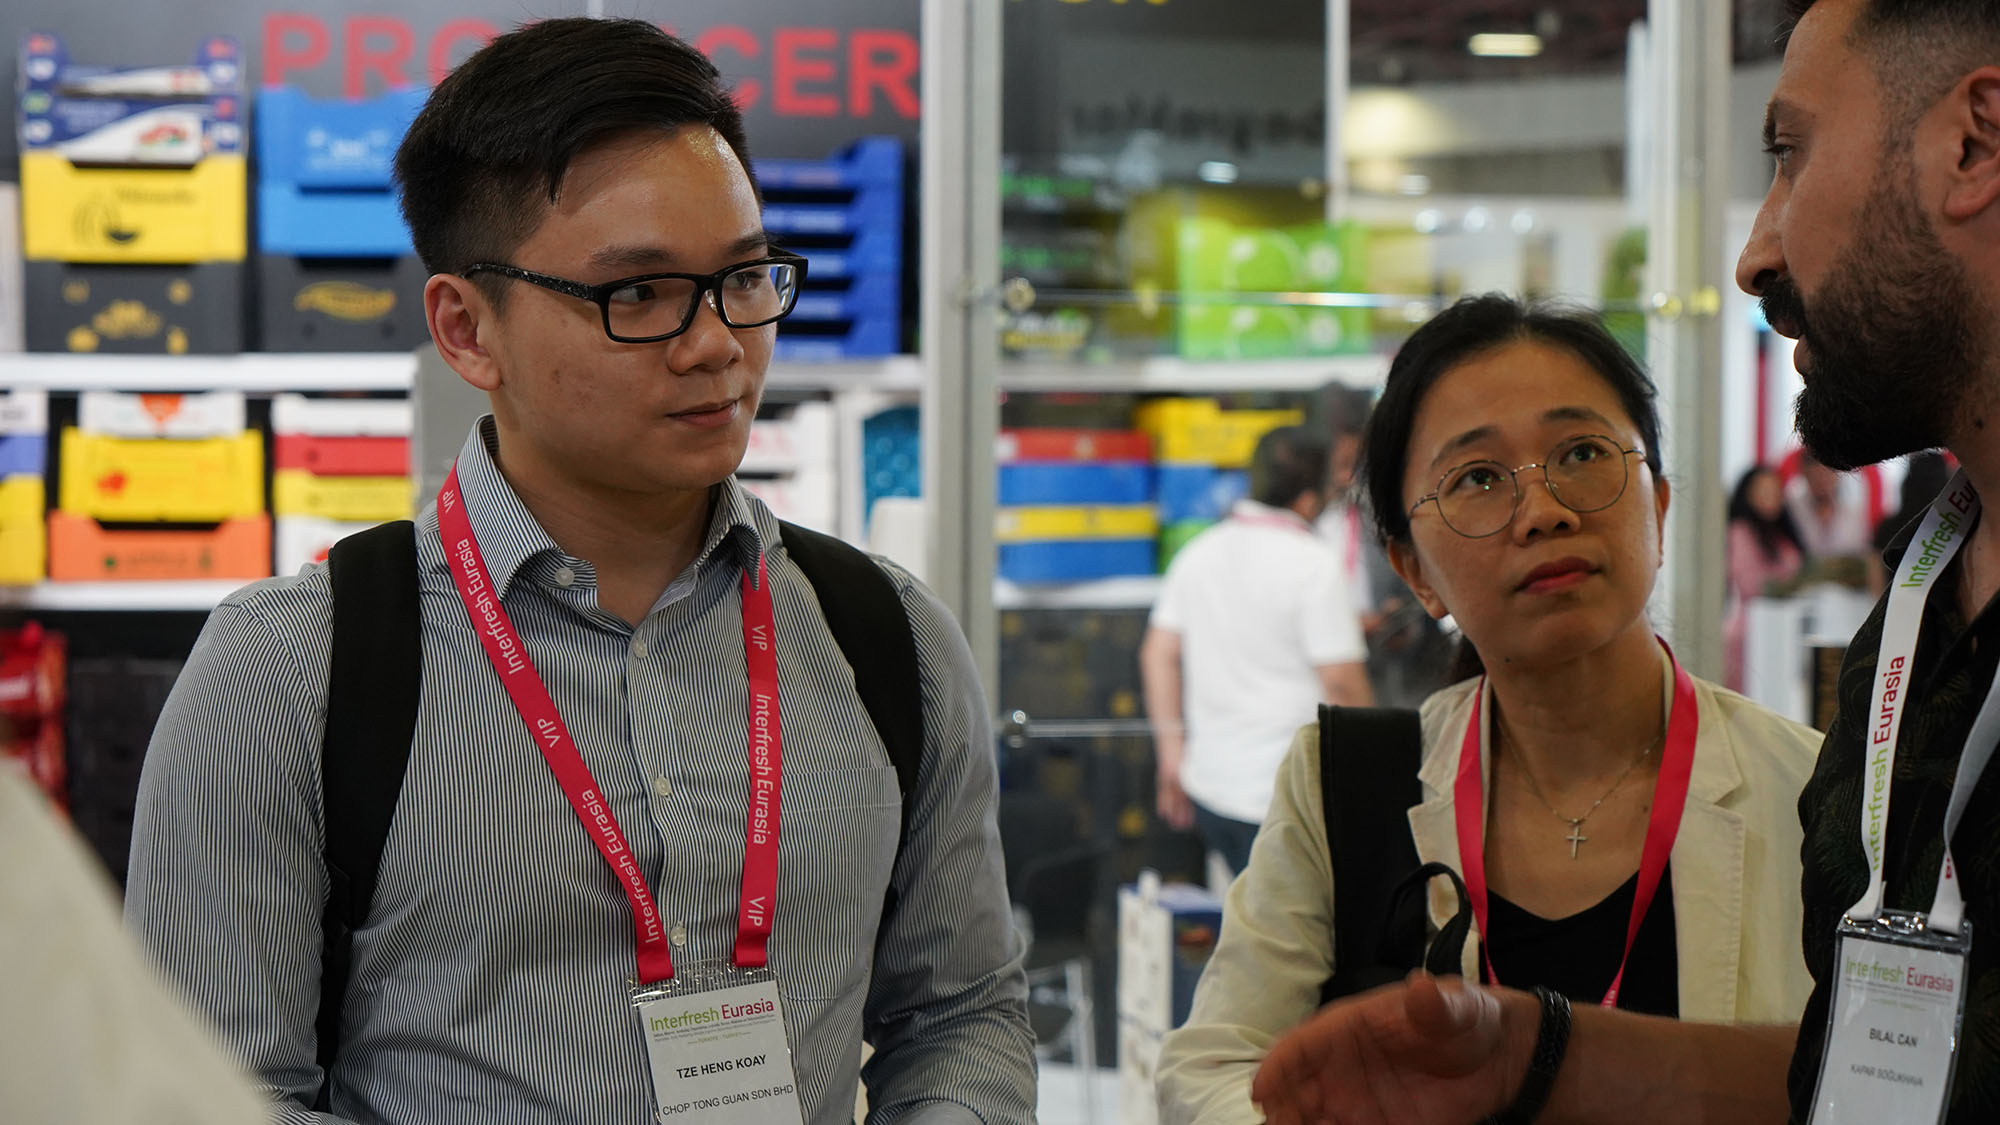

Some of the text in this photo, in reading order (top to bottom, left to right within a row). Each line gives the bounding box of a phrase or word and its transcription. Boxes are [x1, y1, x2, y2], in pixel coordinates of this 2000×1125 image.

[442, 489, 456, 513] VIP
[1900, 511, 1961, 587] Interfresh
[455, 538, 525, 675] Interfresh Eurasia
[751, 625, 768, 651] VIP
[1873, 656, 1906, 745] Eurasia
[537, 718, 561, 748] VIP
[753, 694, 773, 844] Interfresh Eurasia
[582, 789, 660, 943] Interfresh Eurasia
[747, 896, 766, 926] VIP
[1845, 956, 1903, 983] Interfresh
[1906, 967, 1954, 992] Eurasia
[650, 1008, 720, 1032] Interfresh
[721, 998, 774, 1020] Eurasia
[1869, 1028, 1918, 1048] BILAL CAN
[676, 1055, 767, 1079] TZE HENG KOAY
[662, 1084, 794, 1116] CHOP TONG GUAN SDN BHD
